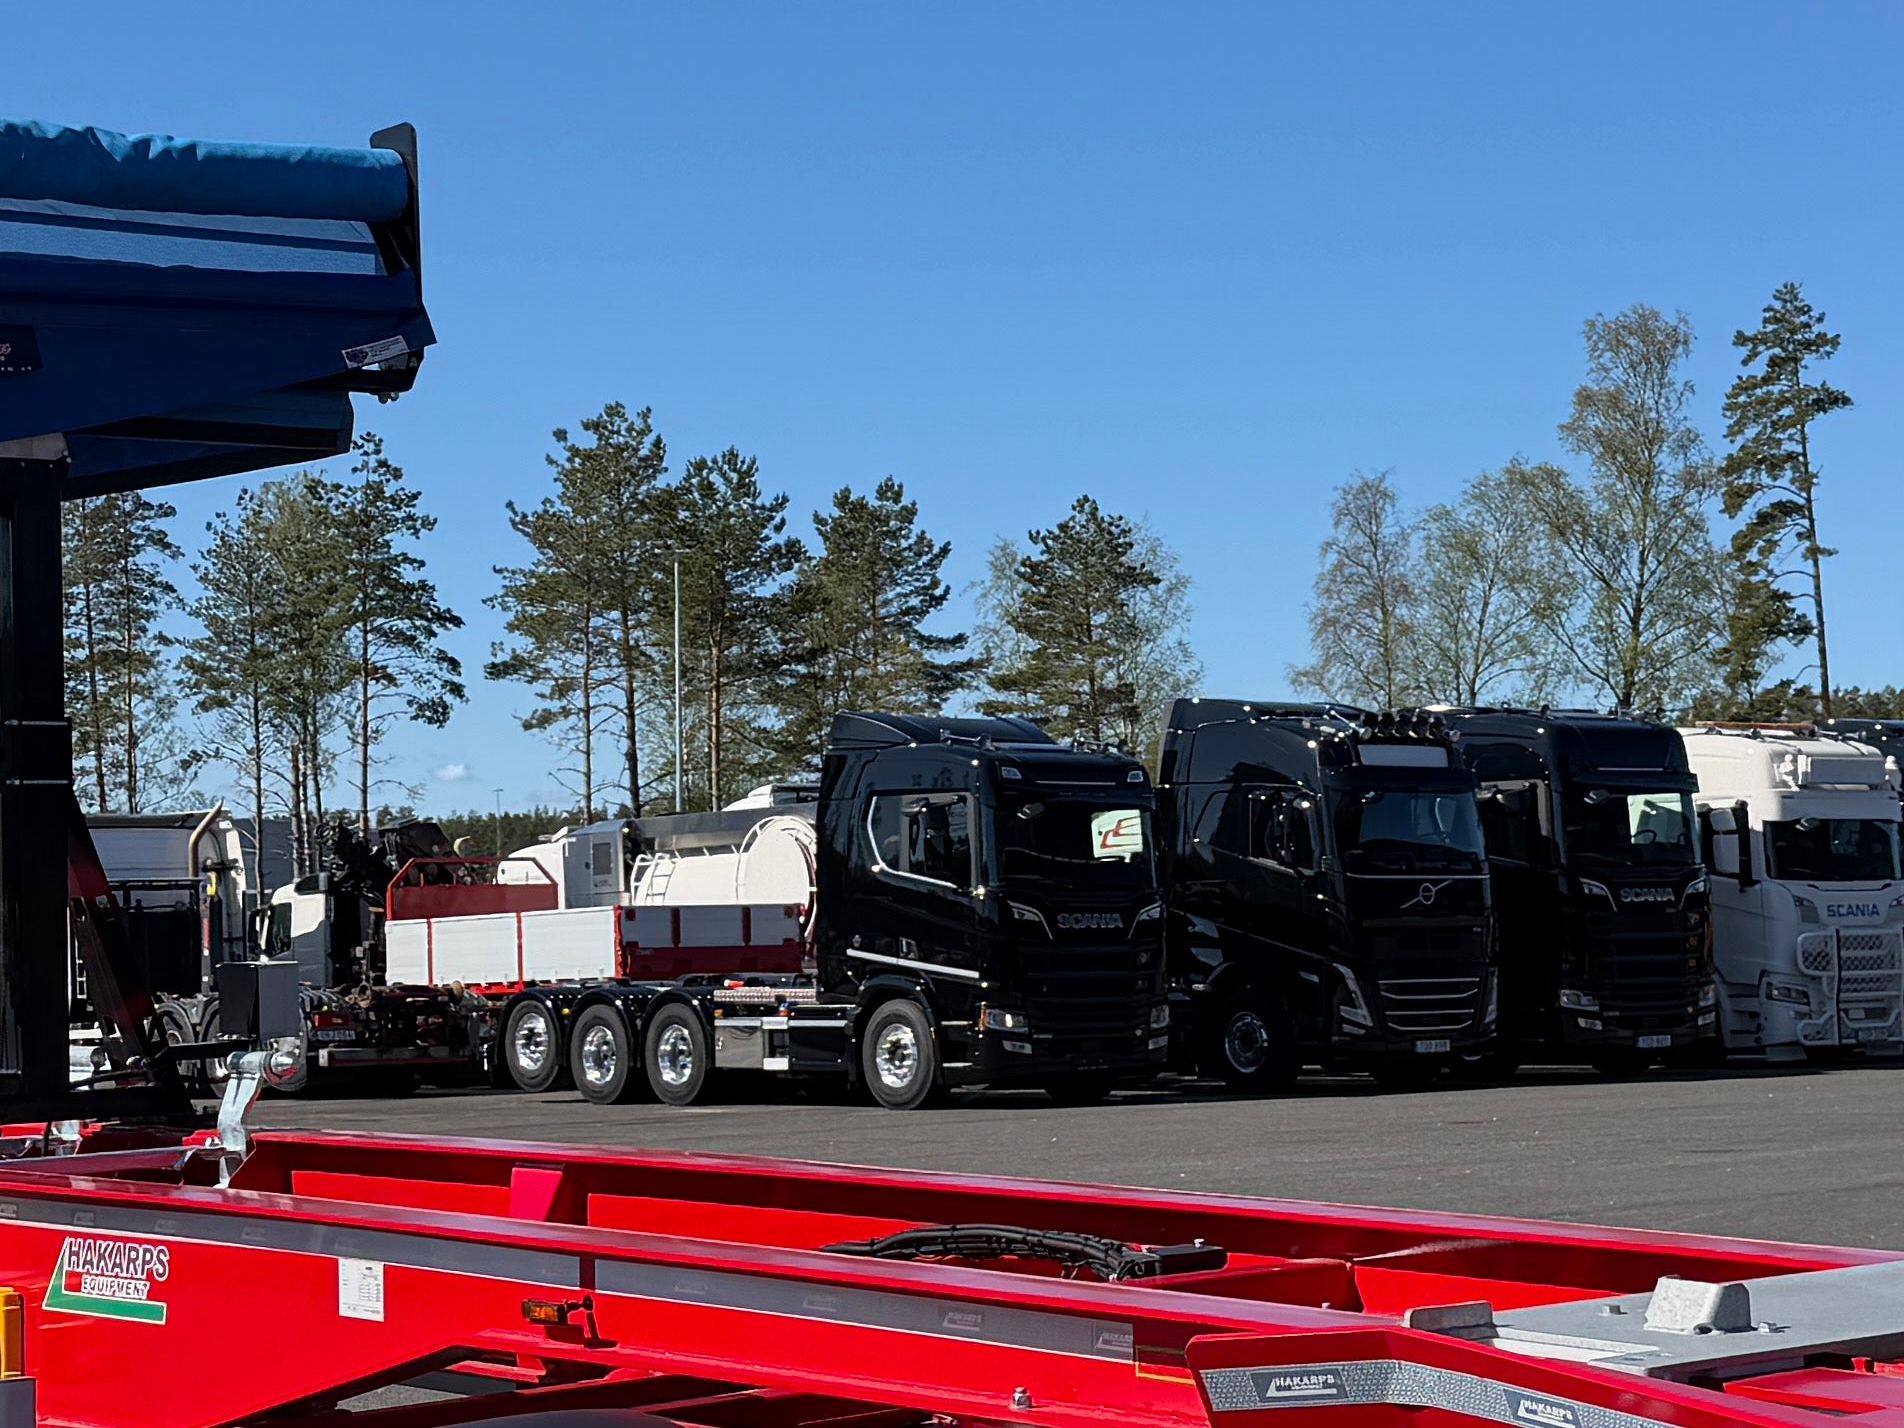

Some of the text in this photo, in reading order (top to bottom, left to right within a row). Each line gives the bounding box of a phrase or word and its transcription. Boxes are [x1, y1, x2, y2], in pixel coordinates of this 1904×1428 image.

[1620, 888, 1675, 902] SCANIA
[1827, 903, 1880, 918] SCANIA
[1057, 913, 1123, 928] SCANIA
[67, 1238, 169, 1280] HAKARPS
[83, 1277, 149, 1297] EQUIPMENT
[1275, 1374, 1336, 1387] HAKARPS
